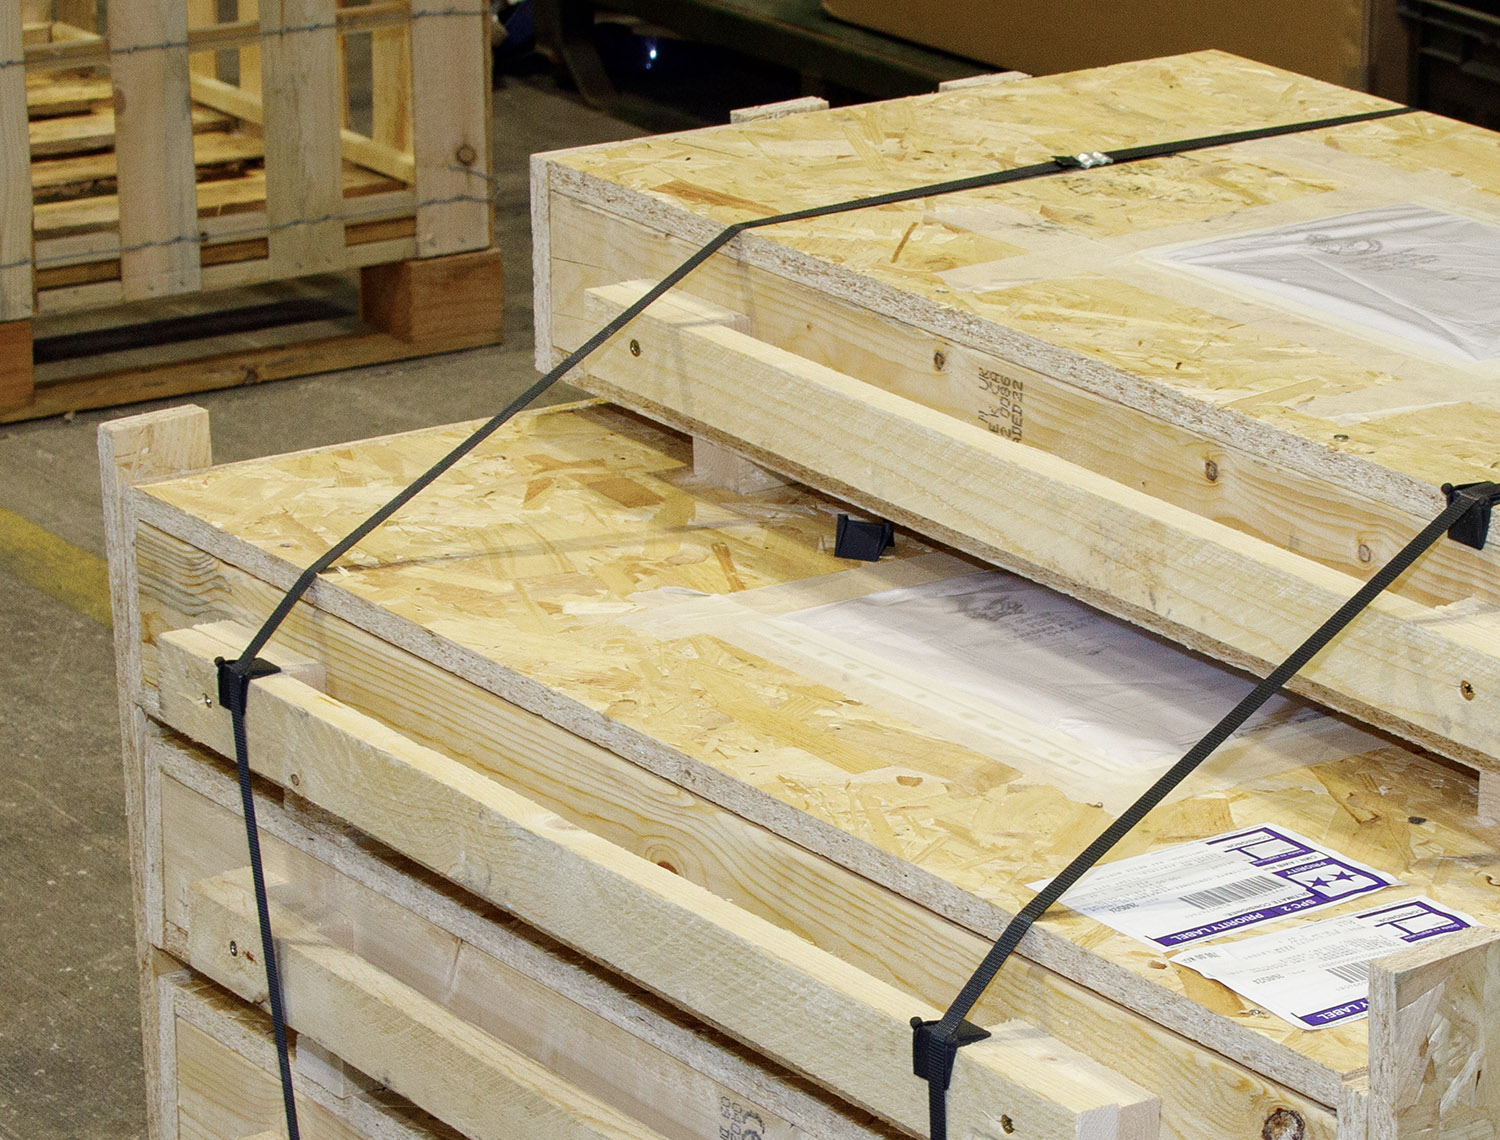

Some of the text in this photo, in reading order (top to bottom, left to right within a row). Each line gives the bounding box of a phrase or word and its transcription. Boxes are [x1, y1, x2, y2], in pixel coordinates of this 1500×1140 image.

[1285, 861, 1328, 875] PRIORITY
[1290, 899, 1317, 909] SPC
[1211, 912, 1265, 931] PRIORITY
[1170, 928, 1211, 941] LABEL
[1317, 1004, 1358, 1019] LABEL
